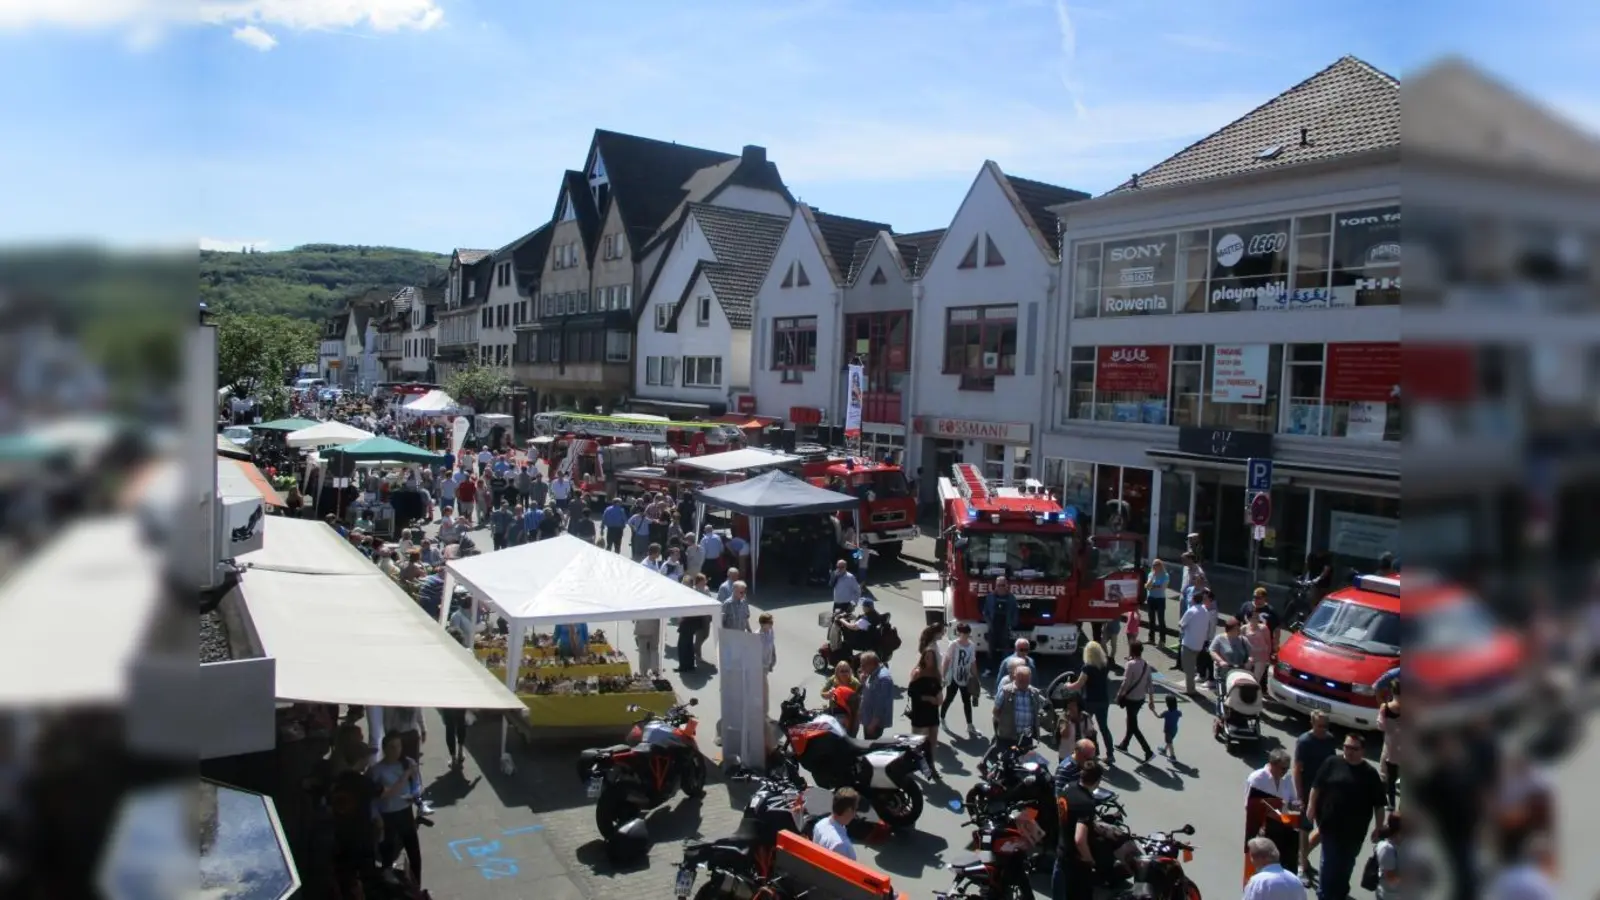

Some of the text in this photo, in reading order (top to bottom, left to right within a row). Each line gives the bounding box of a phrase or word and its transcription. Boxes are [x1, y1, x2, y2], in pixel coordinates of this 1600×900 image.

[1110, 242, 1167, 262] SONY
[1248, 232, 1287, 255] LEGO
[1212, 281, 1285, 304] playmobil
[1105, 294, 1167, 313] Rowenta
[938, 420, 1008, 437] ROSSMANN
[1253, 463, 1267, 486] P
